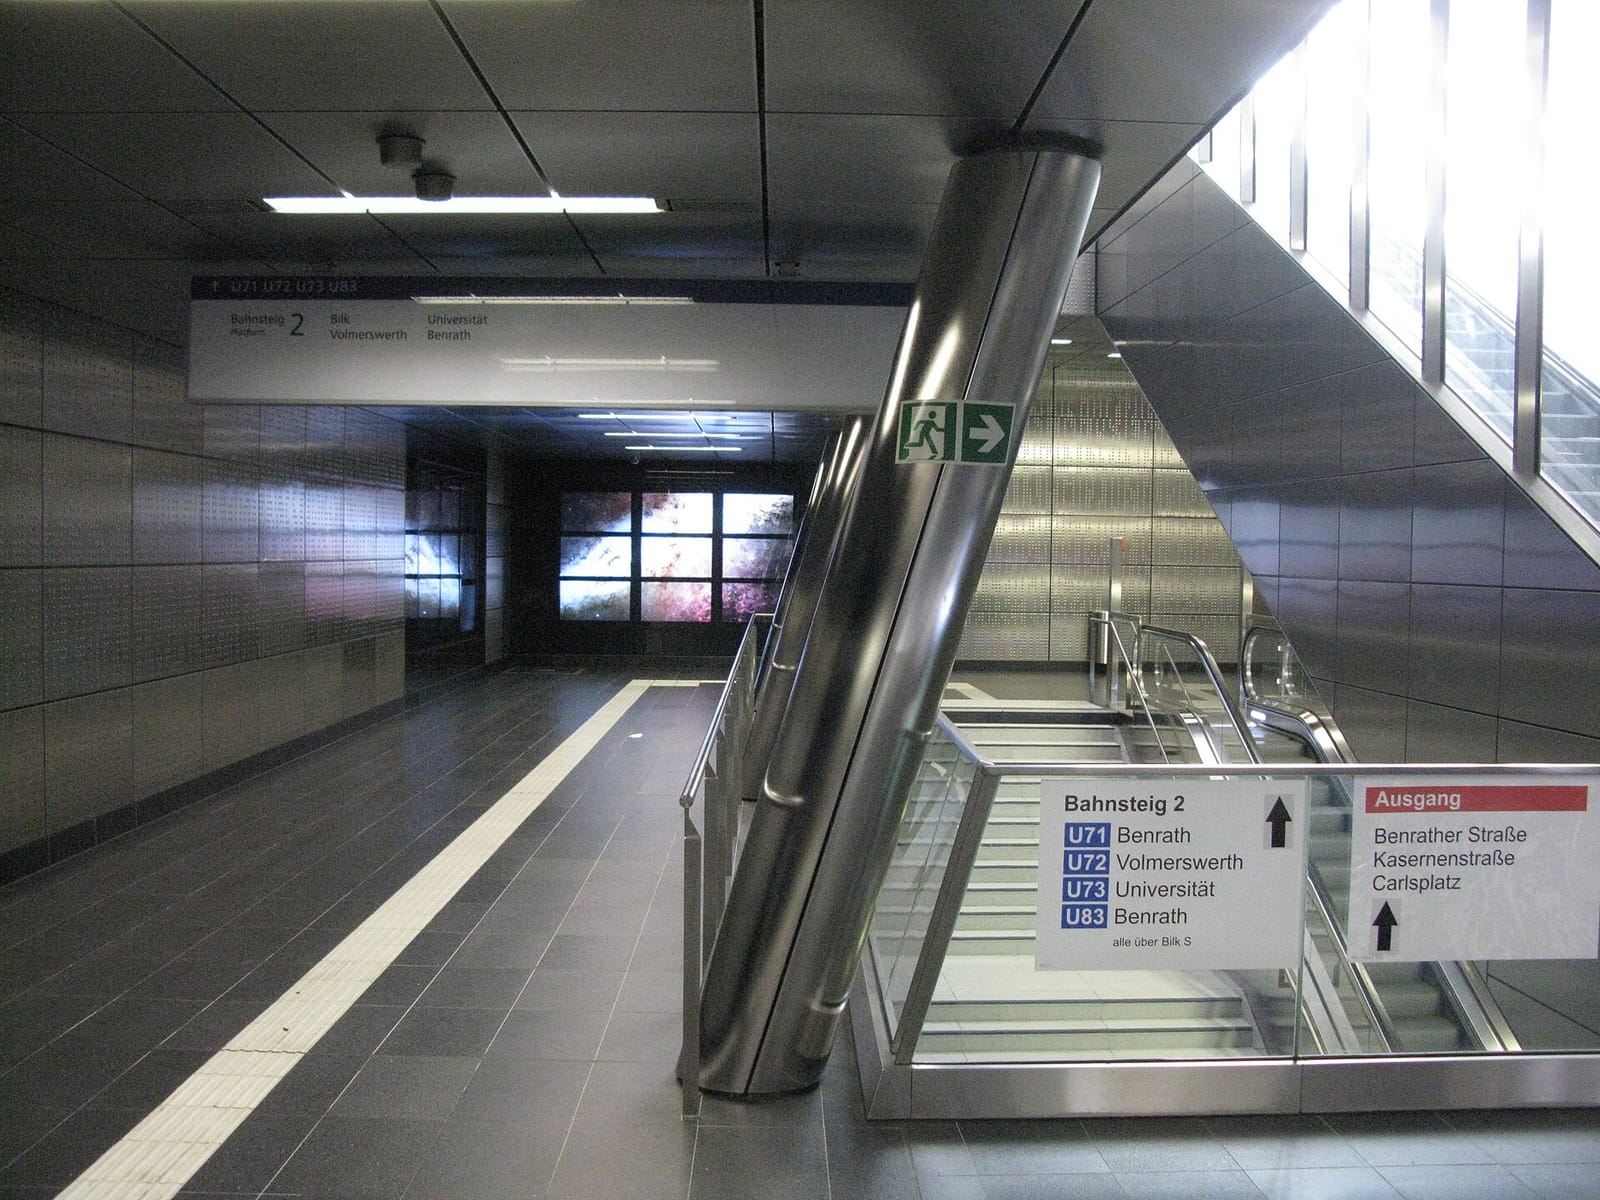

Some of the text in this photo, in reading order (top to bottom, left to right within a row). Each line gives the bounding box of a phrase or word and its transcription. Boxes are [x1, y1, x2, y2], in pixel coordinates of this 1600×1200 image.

[232, 280, 357, 292] U71 U72 U73 U83
[231, 313, 304, 336] Bahnsteig 2
[331, 314, 349, 325] Bilk
[428, 314, 487, 325] Universität
[331, 330, 407, 340] Volmerswerth
[428, 330, 471, 340] Benrath
[1064, 795, 1185, 815] Bahnsteig 2
[1375, 791, 1461, 810] Ausgang
[1069, 826, 1191, 843] U71 Benrath
[1375, 826, 1527, 844] Benrather Straße
[1068, 854, 1243, 870] U72 Volmerswerth
[1373, 850, 1515, 868] Kasernenstraße
[1067, 881, 1215, 898] U73 Universität
[1373, 874, 1461, 894] Carlsplatz
[1066, 908, 1187, 925] U83 Benrath
[1112, 936, 1192, 947] alle über Bilk S
